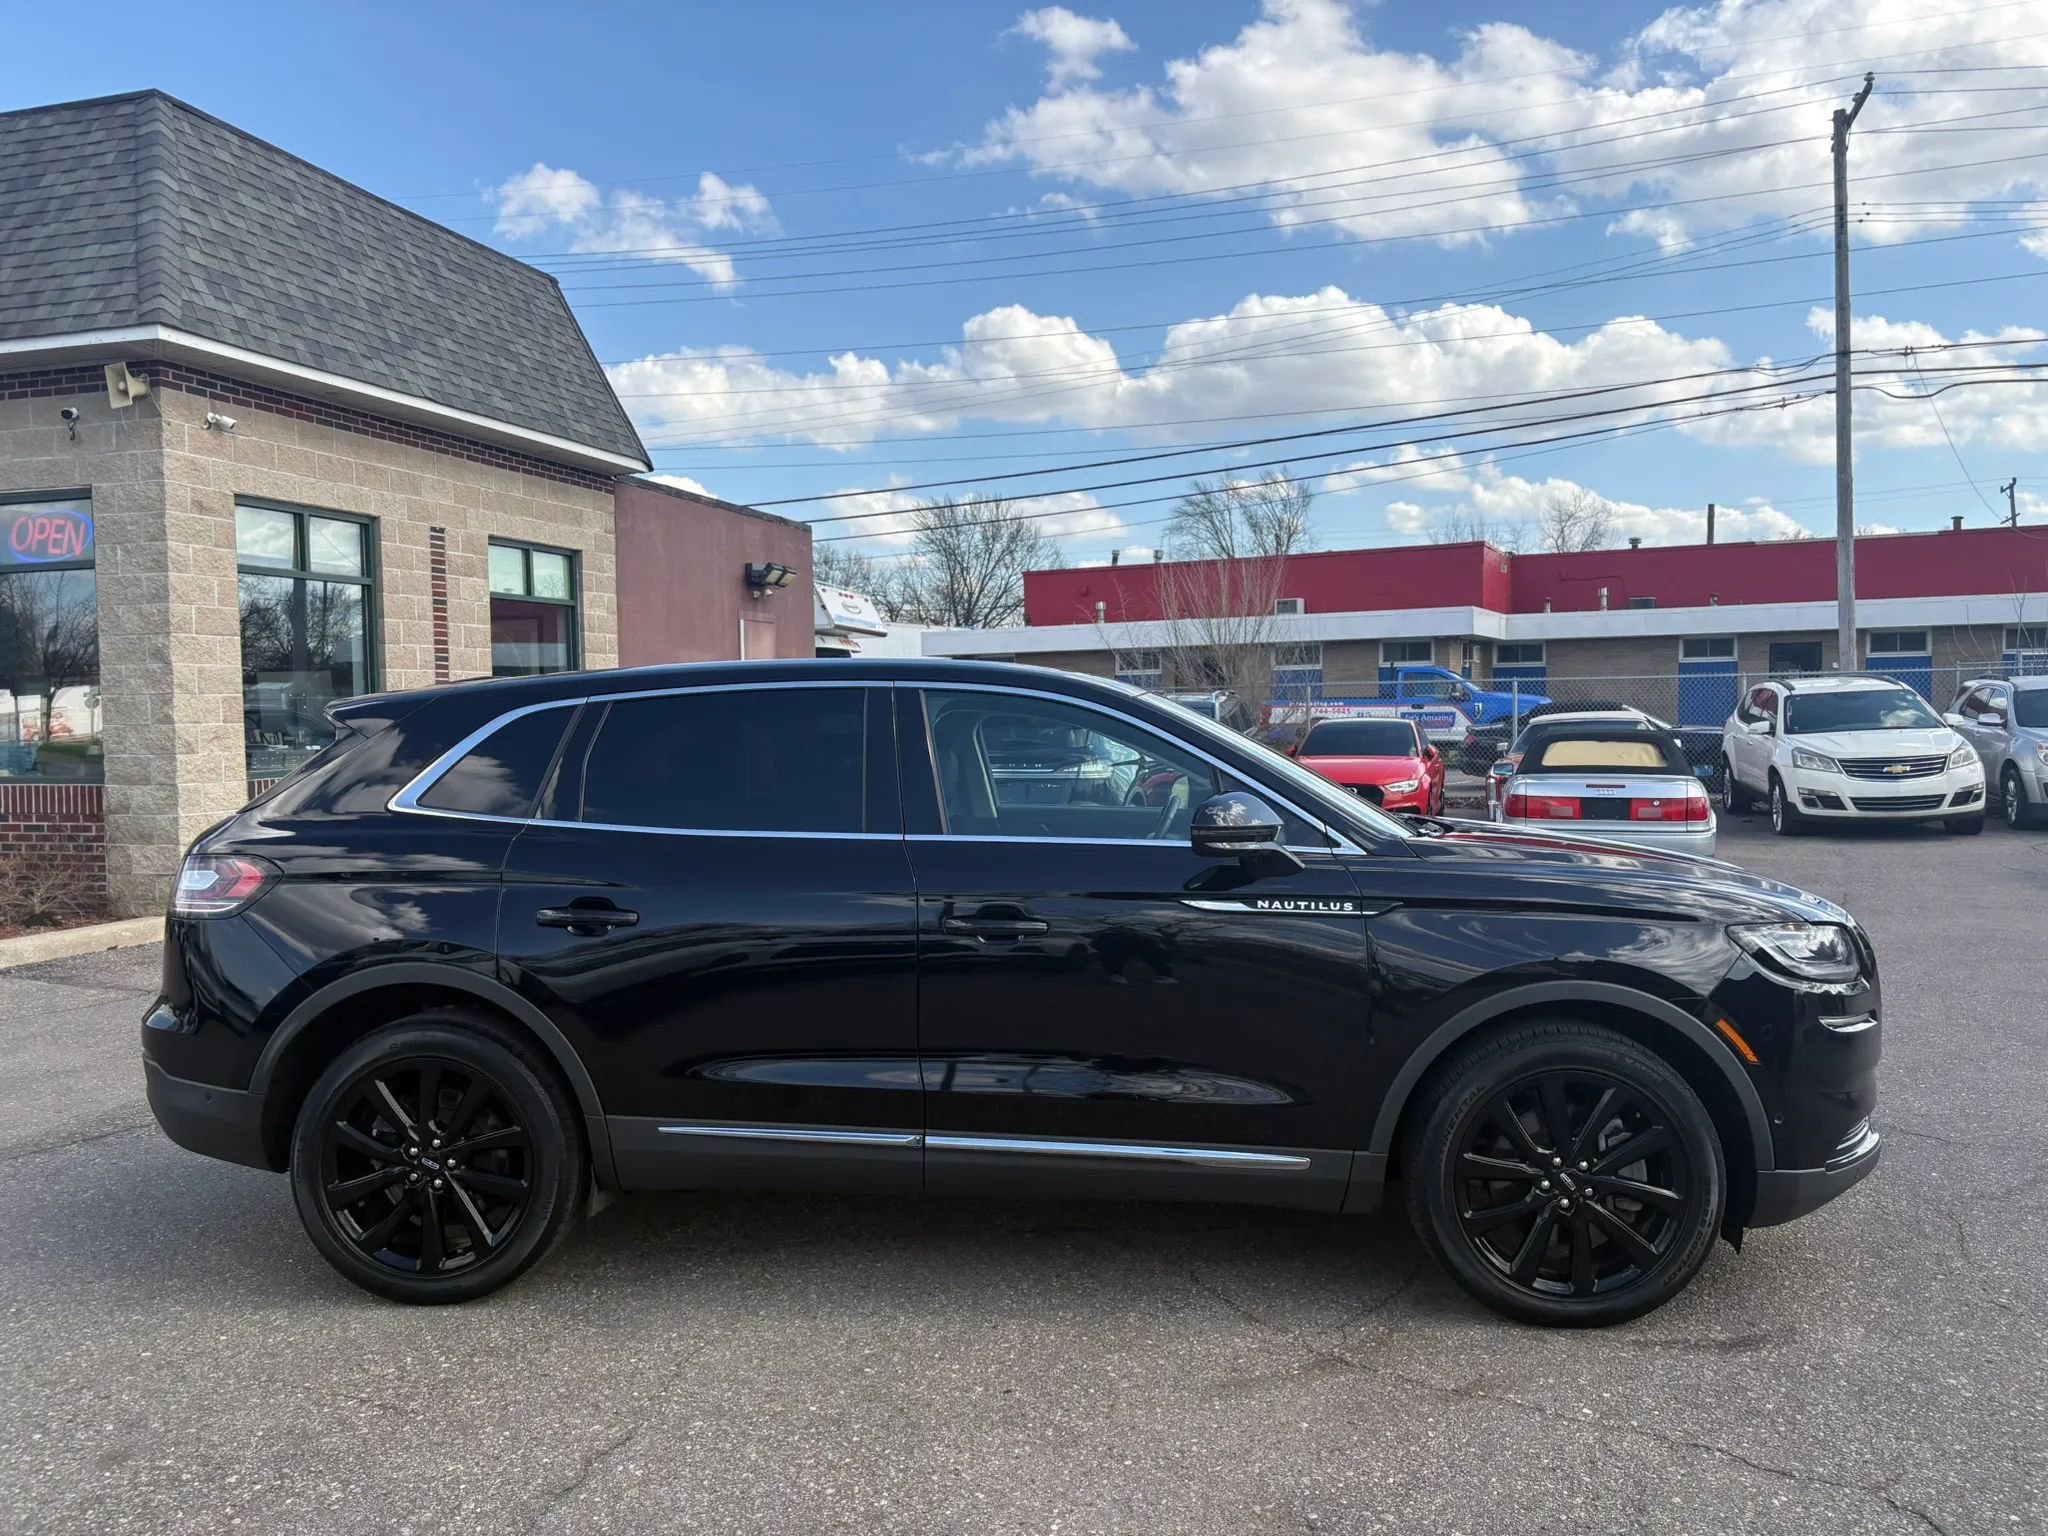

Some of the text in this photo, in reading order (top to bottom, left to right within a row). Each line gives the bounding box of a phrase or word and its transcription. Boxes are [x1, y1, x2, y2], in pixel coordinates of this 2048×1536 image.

[12, 515, 86, 557] OPEN
[1420, 713, 1453, 723] Amazing
[1257, 900, 1353, 911] NAUTILUS
